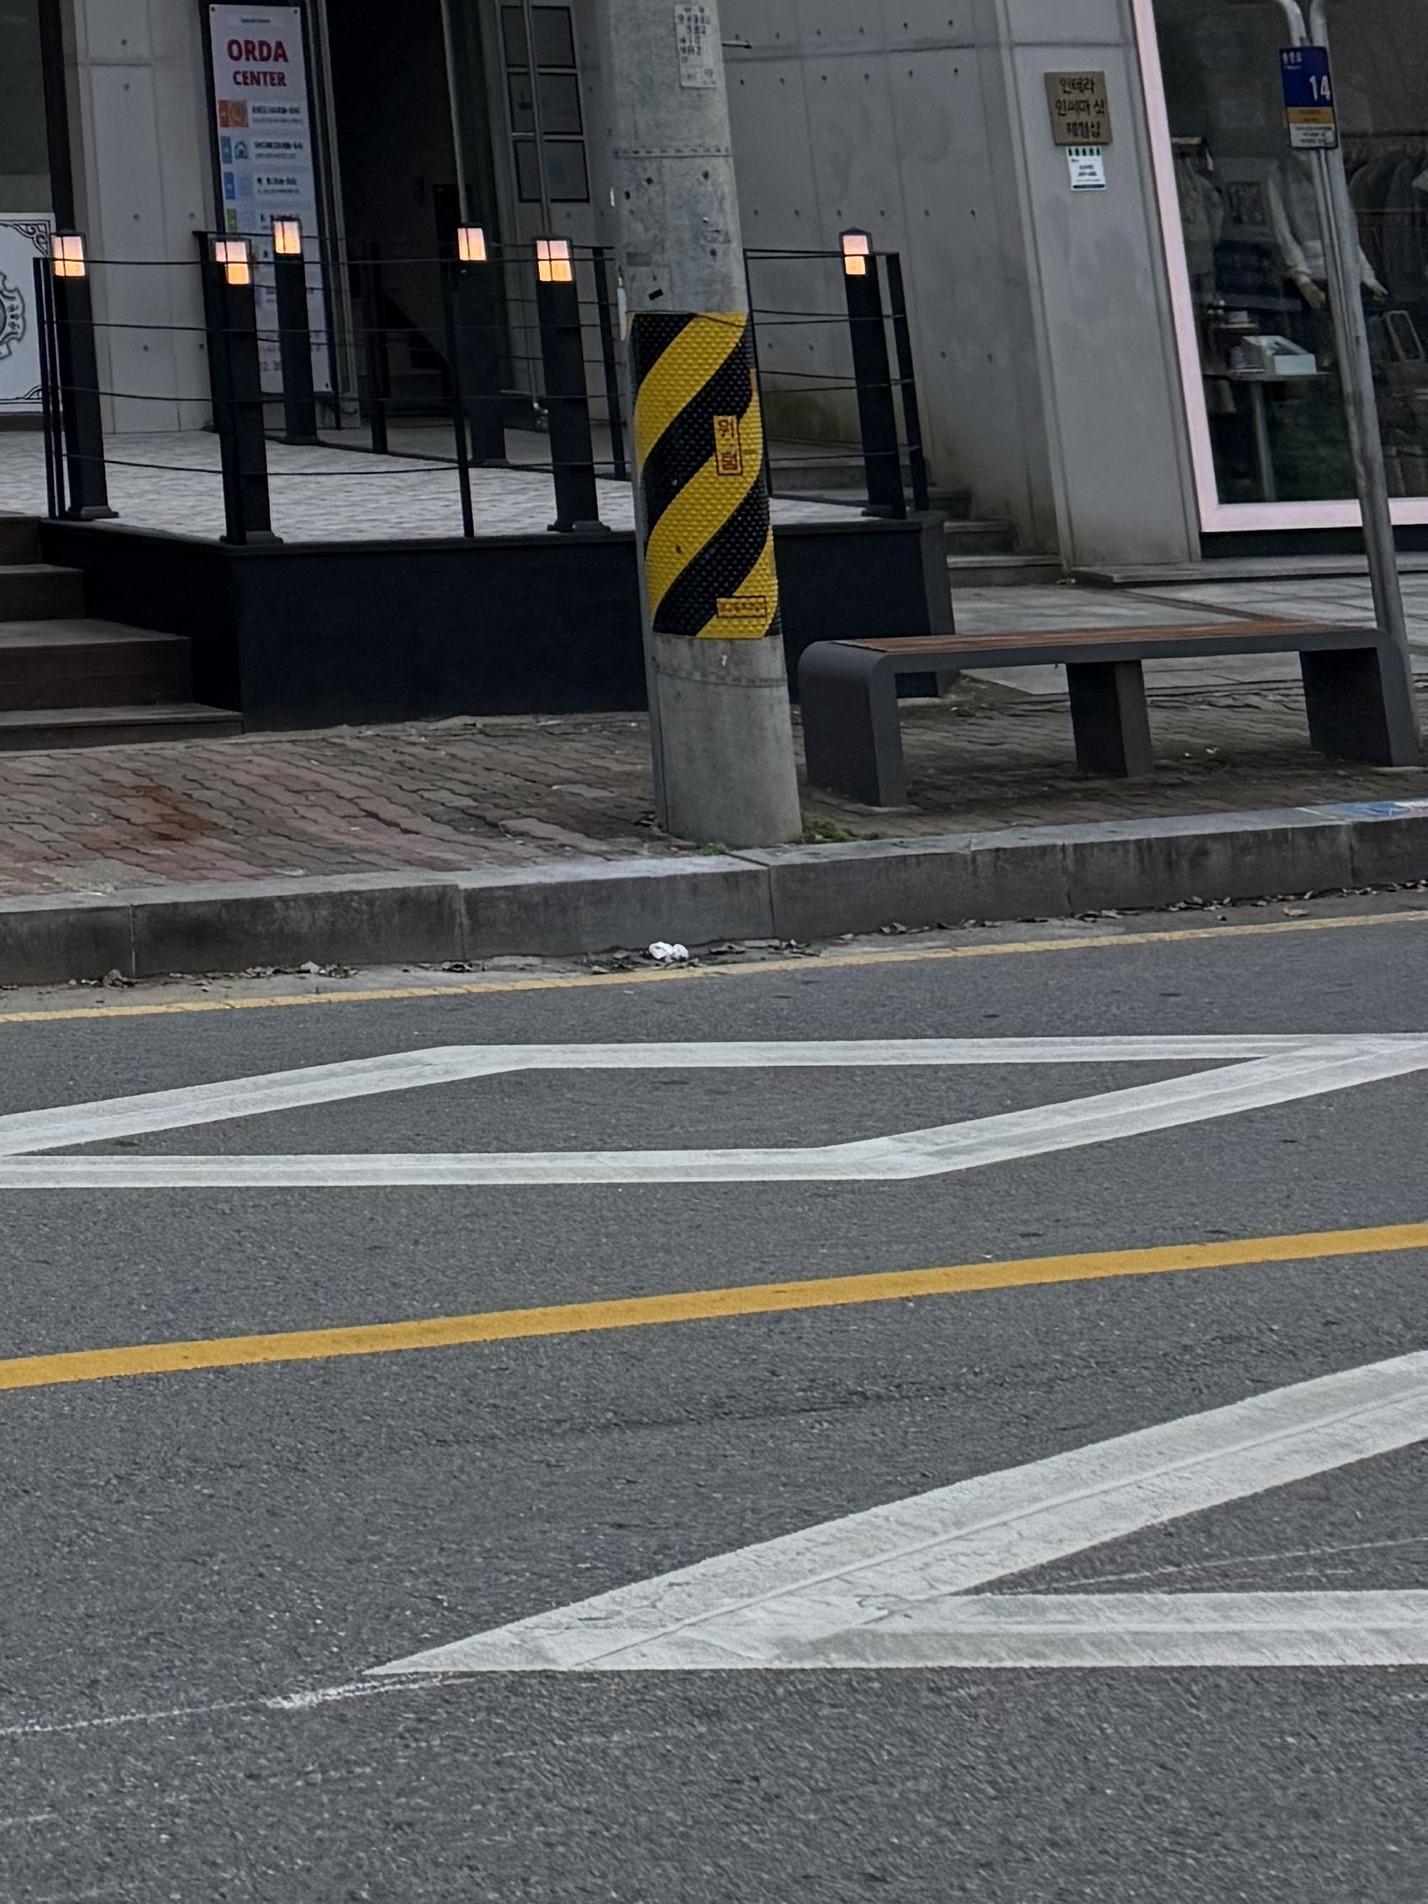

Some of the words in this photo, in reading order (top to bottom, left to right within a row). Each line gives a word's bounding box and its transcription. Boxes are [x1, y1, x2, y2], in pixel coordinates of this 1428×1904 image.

[226, 38, 289, 63] ORDA
[232, 70, 288, 88] CENTER
[1309, 75, 1331, 101] 14
